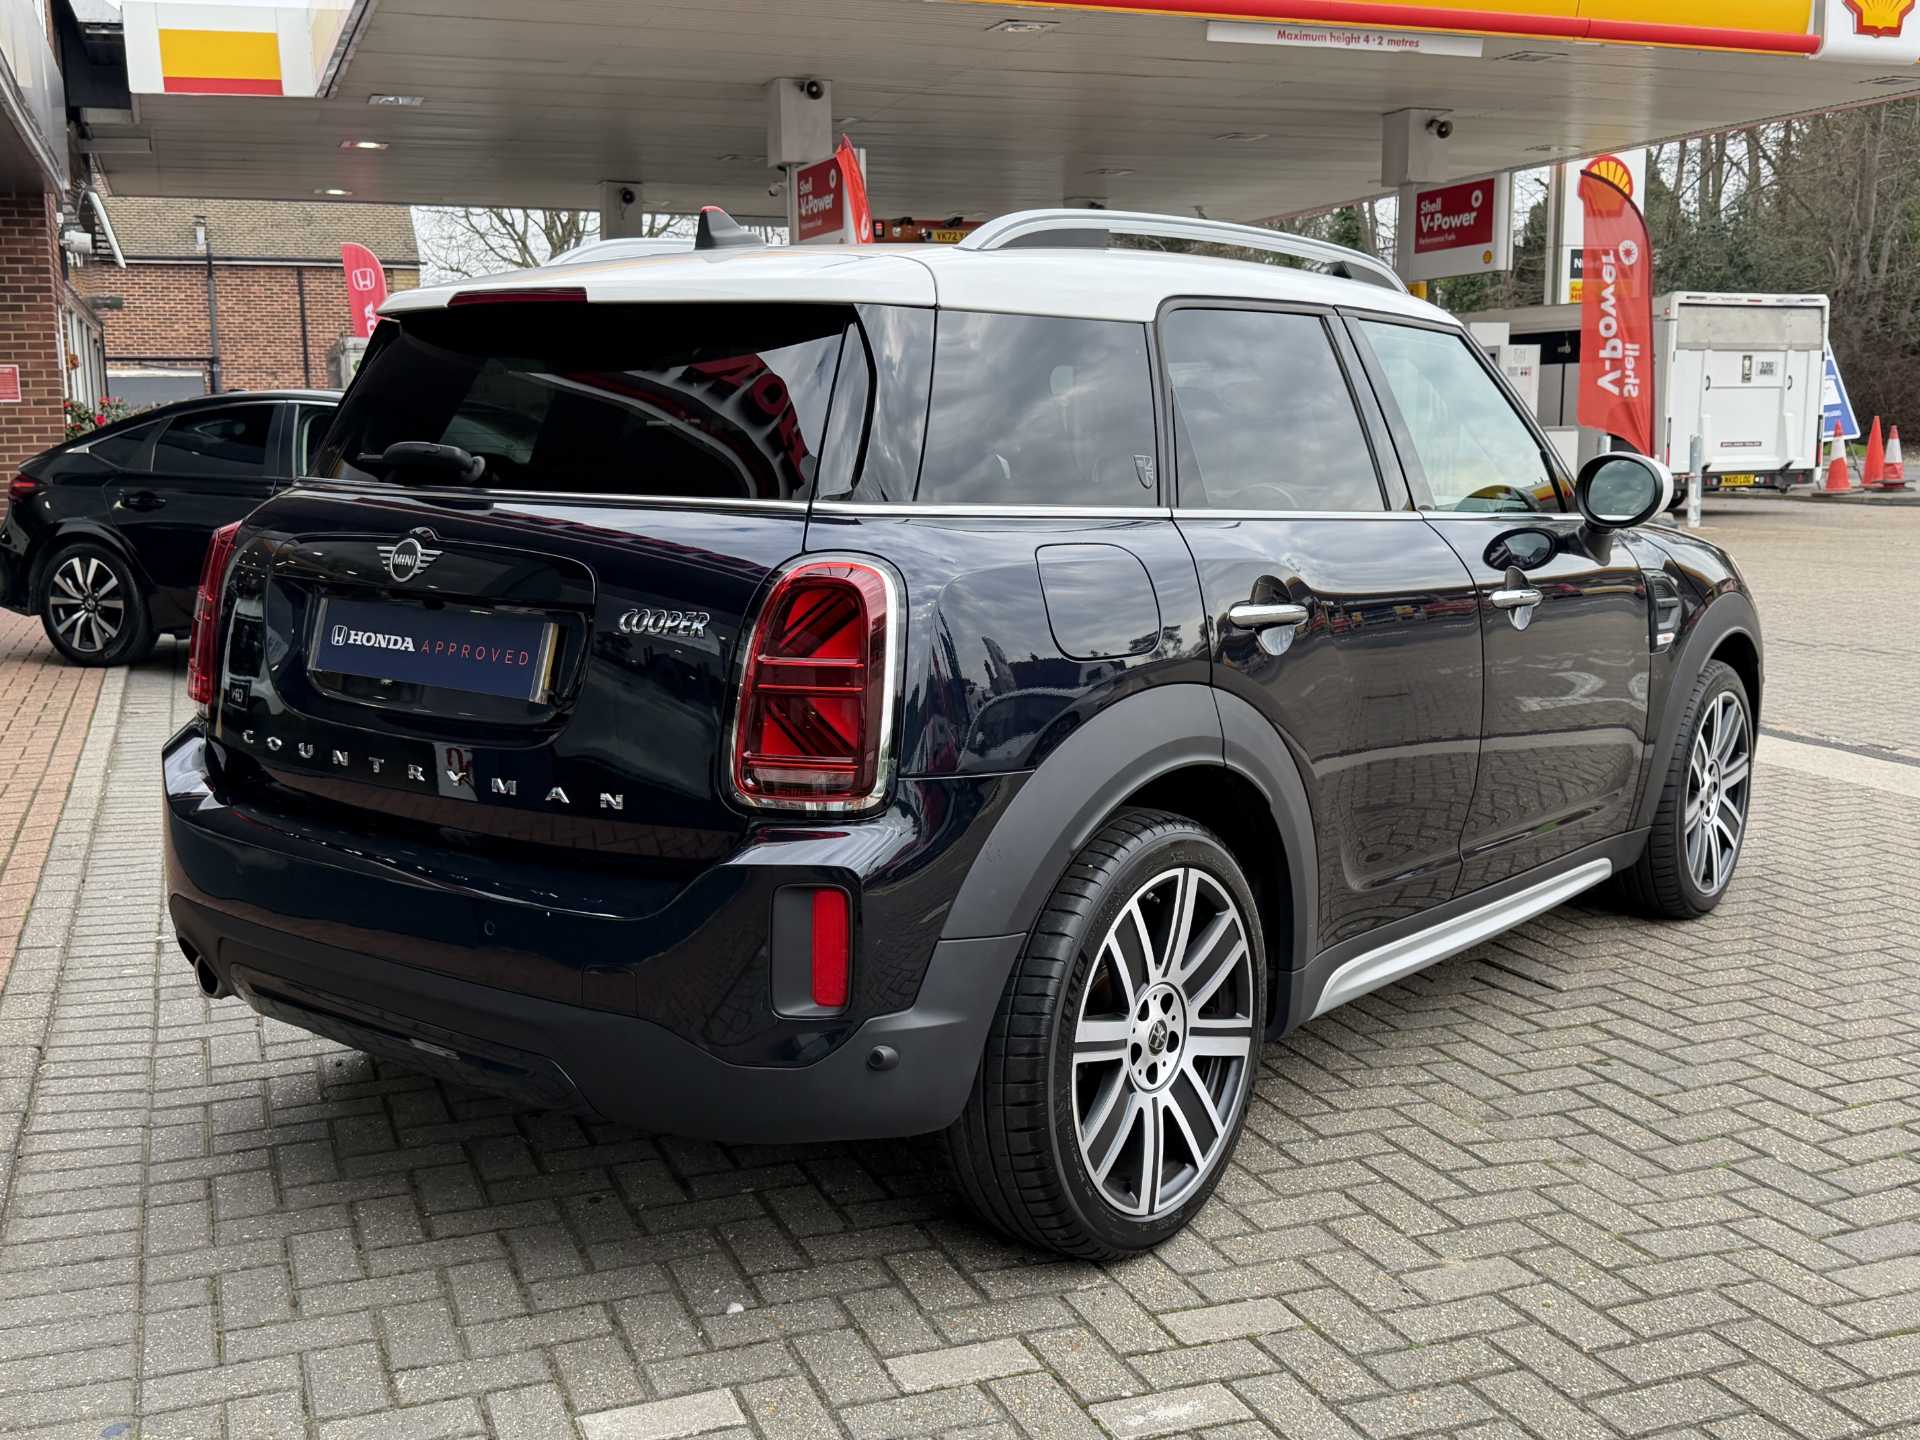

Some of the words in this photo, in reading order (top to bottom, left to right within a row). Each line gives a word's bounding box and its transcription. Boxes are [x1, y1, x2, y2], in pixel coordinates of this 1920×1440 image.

[1276, 29, 1327, 42] Maximum
[1329, 31, 1361, 46] height
[1387, 37, 1420, 48] metres
[799, 176, 813, 196] Shell
[799, 193, 835, 217] V-Power
[1420, 197, 1442, 214] Shell
[1420, 211, 1478, 233] V-Power
[392, 553, 417, 568] MINI
[619, 608, 711, 639] COOPER
[347, 629, 416, 652] HONDA
[420, 639, 530, 666] APPROVED
[241, 729, 624, 811] COUNTRYMAN
